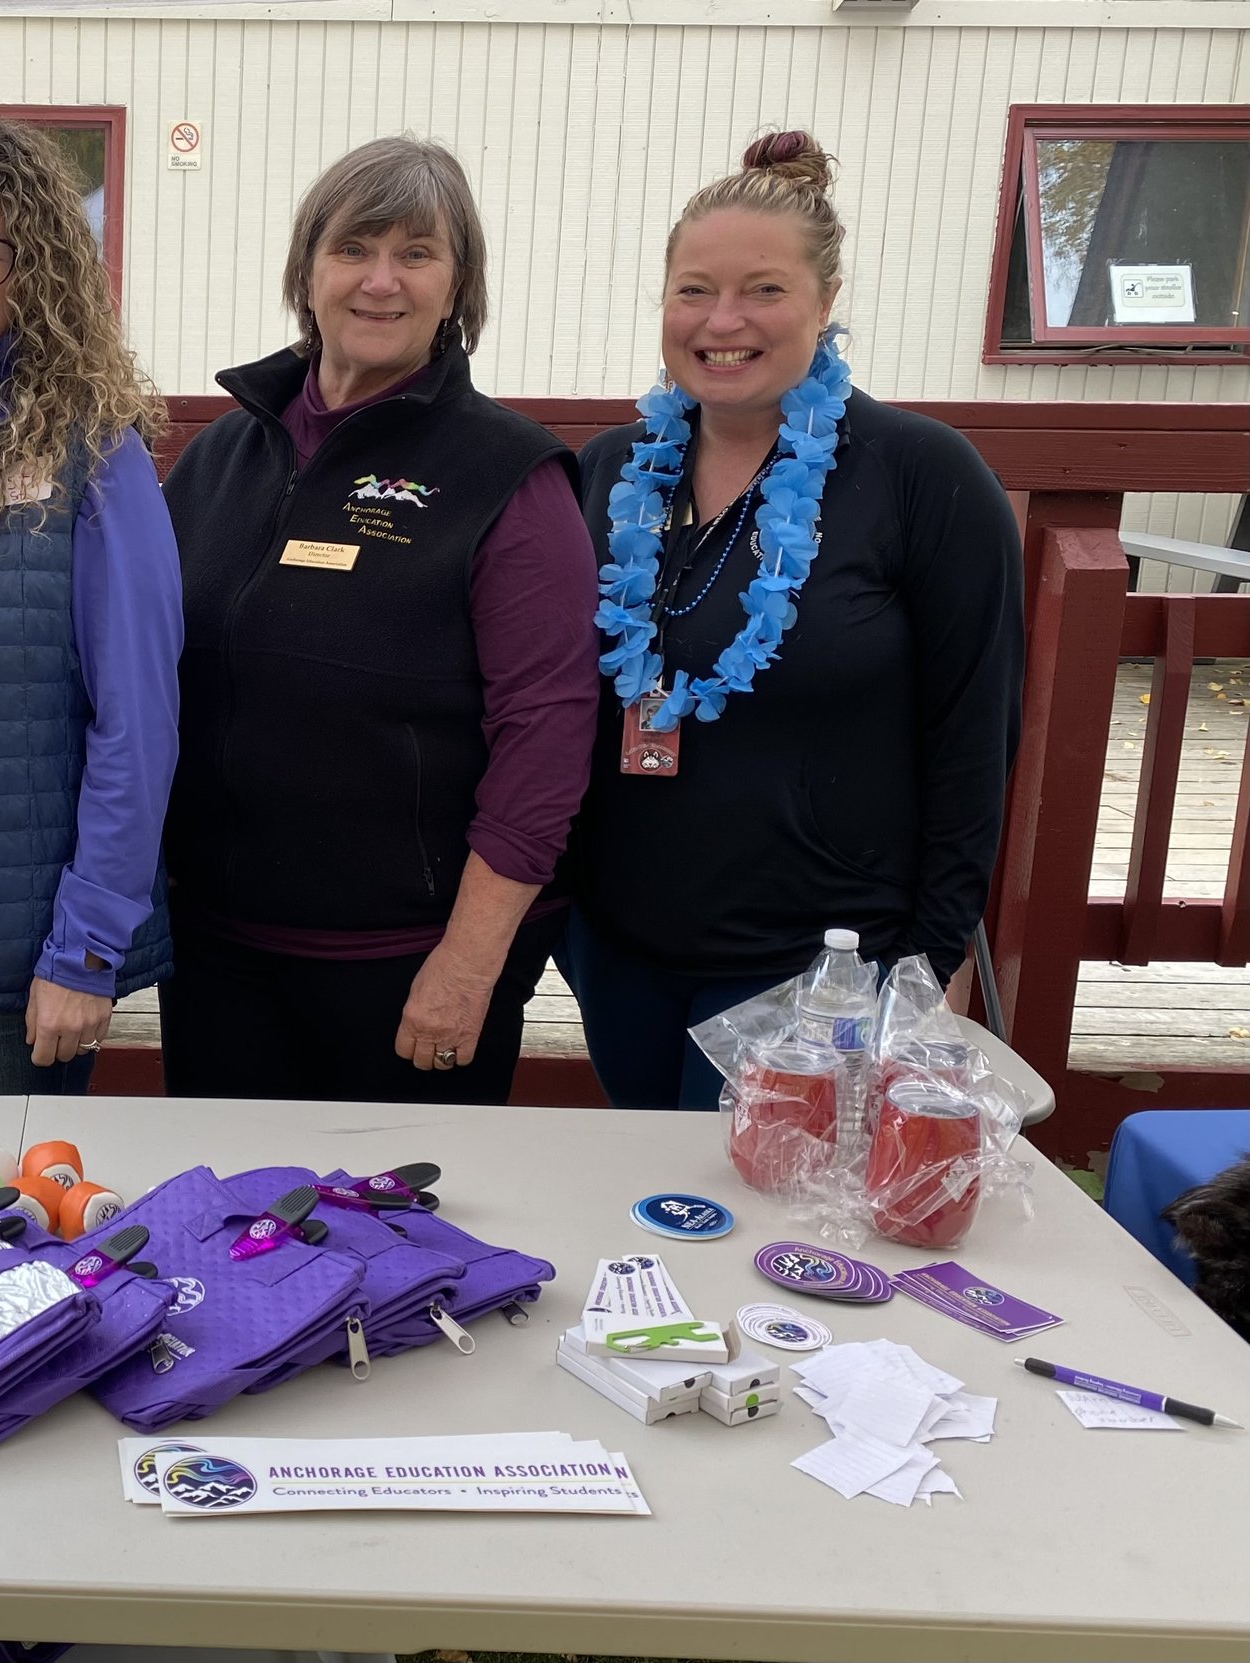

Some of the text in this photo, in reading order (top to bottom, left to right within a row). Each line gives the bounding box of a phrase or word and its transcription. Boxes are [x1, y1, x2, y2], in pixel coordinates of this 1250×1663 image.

[299, 543, 346, 553] Barbara Clark
[269, 1466, 378, 1479] ANCHORAGE
[385, 1465, 487, 1479] EDUCATION
[494, 1463, 613, 1478] ASSOCIATION
[272, 1486, 369, 1499] Connecting
[370, 1485, 452, 1496] Educators
[477, 1486, 548, 1498] Inspiring
[549, 1486, 623, 1496] Students
